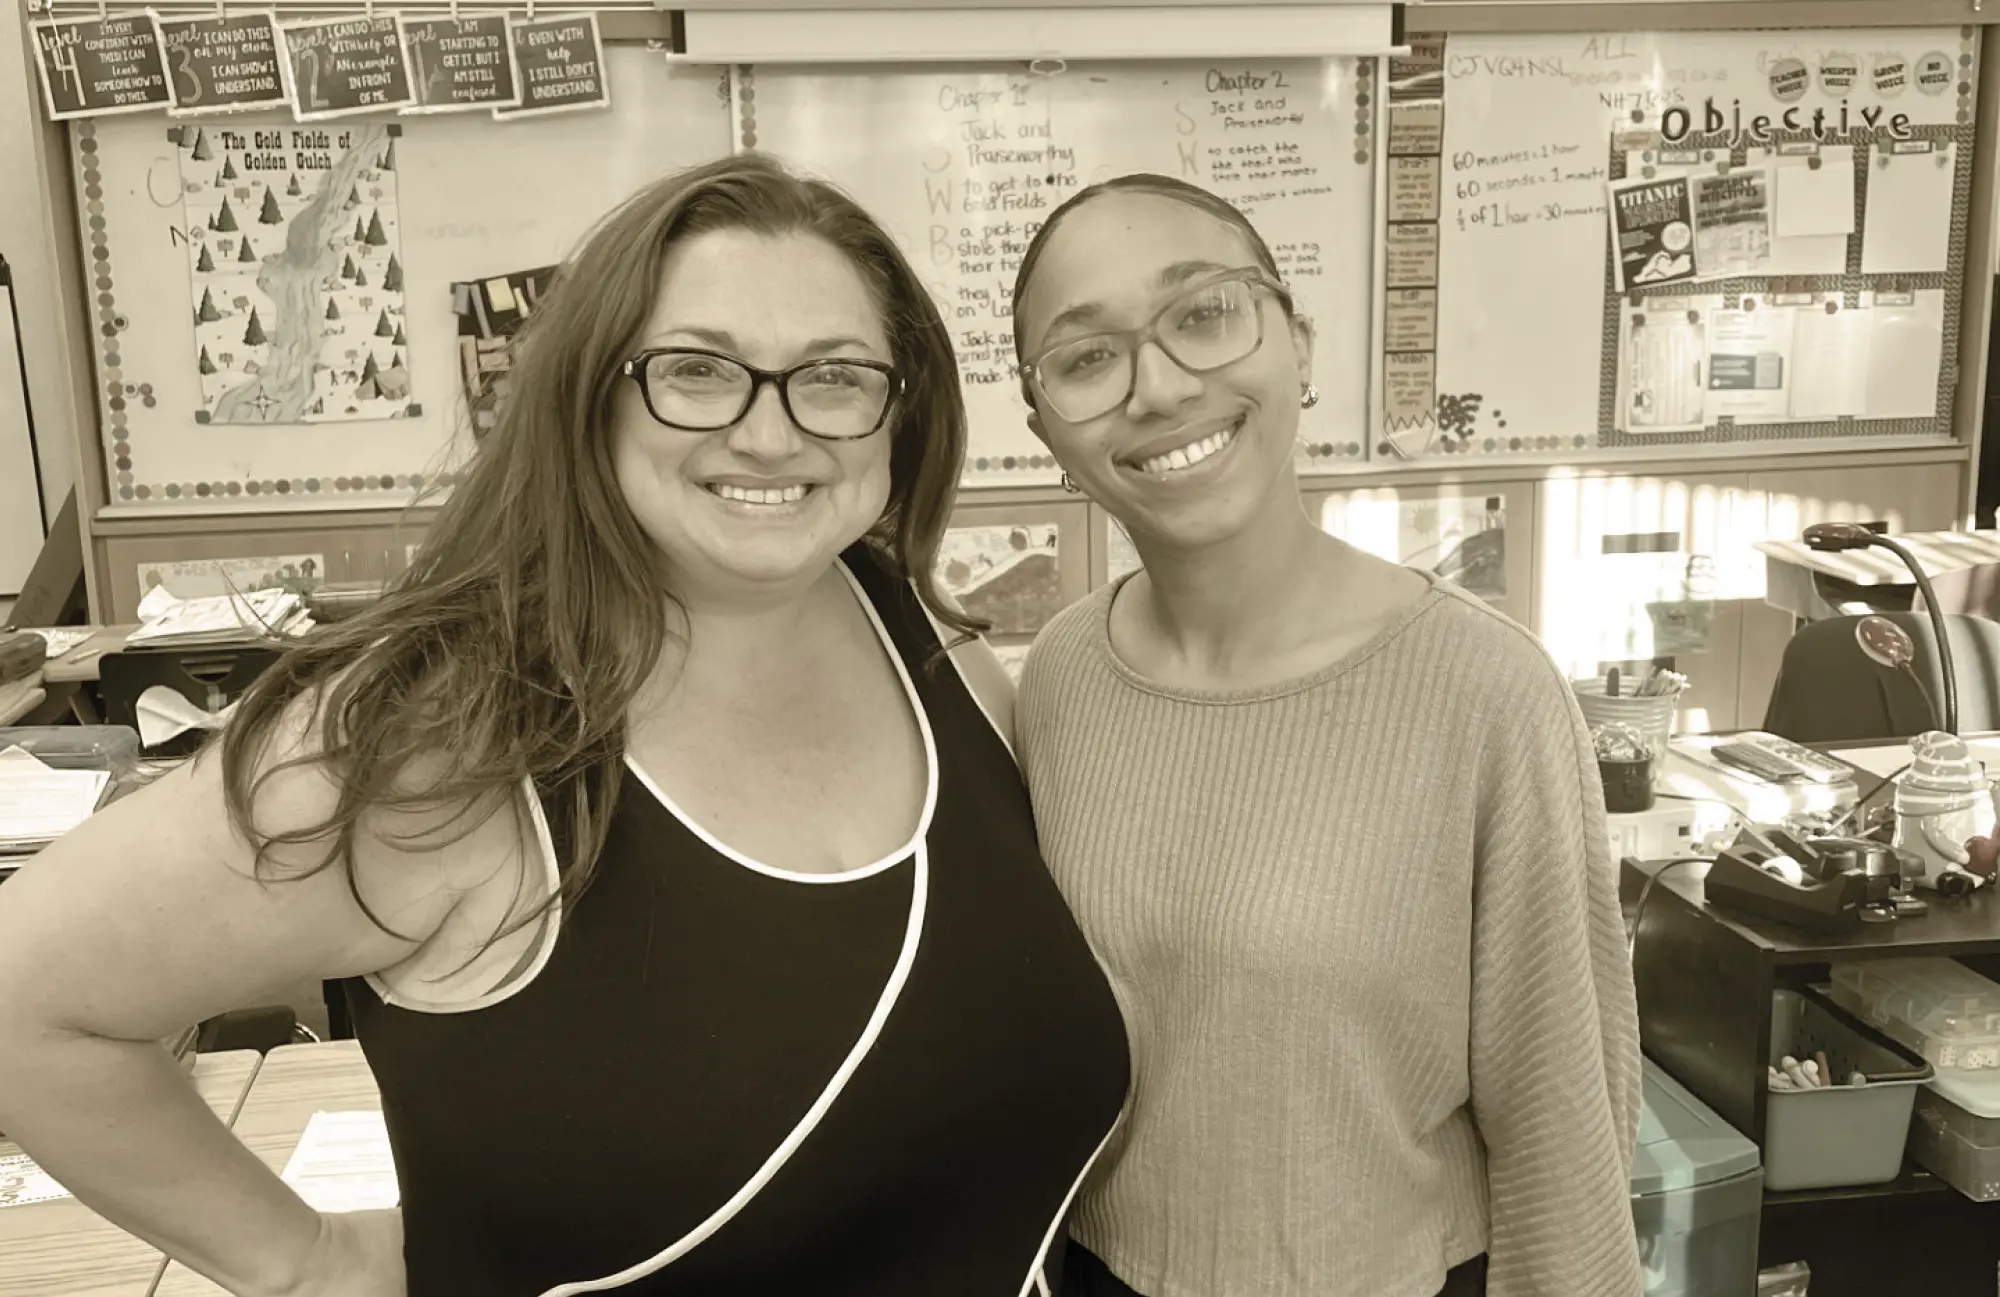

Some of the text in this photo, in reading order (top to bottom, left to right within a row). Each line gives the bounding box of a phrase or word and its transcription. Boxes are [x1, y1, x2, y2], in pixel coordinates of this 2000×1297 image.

[211, 30, 232, 44] CAN
[233, 28, 246, 42] DO
[246, 26, 271, 41] THIS
[333, 23, 355, 37] CAN
[355, 21, 368, 35] DO
[369, 18, 393, 33] THIS
[404, 24, 437, 45] evel
[464, 20, 478, 33] AM
[85, 34, 154, 51] CONFIDENT WITH
[329, 39, 356, 54] WITH
[383, 34, 397, 47] OR
[439, 36, 486, 51] STARTING
[487, 35, 499, 47] TO
[528, 31, 554, 46] EVEN
[555, 27, 584, 42] WITH
[128, 48, 146, 61] CAN
[1582, 36, 1637, 60] ALL
[336, 59, 350, 72] AN
[443, 53, 459, 68] GET
[476, 52, 492, 65] BUT
[171, 44, 202, 104] 3
[218, 64, 239, 78] CAN
[240, 61, 268, 76] SHOW
[301, 48, 329, 108] 2
[454, 68, 495, 83] AM STILL
[536, 65, 565, 81] STILL
[566, 61, 595, 78] DON'T
[1820, 67, 1857, 76] WHISPER
[94, 74, 162, 93] SOMEONE HOW TO
[215, 76, 278, 96] UNDERSTAND.
[348, 72, 392, 90] IN FRONT
[1206, 68, 1290, 96] Chapter 2
[1824, 77, 1850, 87] VOICE
[1875, 75, 1905, 90] VOICE
[1919, 73, 1948, 85] VOICE
[114, 92, 126, 104] DO
[360, 90, 371, 104] OF
[532, 80, 599, 99] UNDERSTAND.
[1255, 97, 1286, 111] and
[959, 118, 1052, 142] Jack and
[1661, 97, 1910, 147] Objective
[221, 130, 350, 150] The Gold Fields of
[1229, 144, 1267, 155] catch
[1275, 141, 1299, 153] the
[245, 152, 332, 170] Golden Gulch
[1452, 150, 1475, 171] 60
[1476, 150, 1531, 168] minutes
[1541, 145, 1549, 158] 1
[1552, 143, 1580, 155] hour
[963, 178, 982, 195] to
[989, 176, 1019, 199] get
[1025, 174, 1042, 189] to
[1456, 180, 1480, 200] 60
[1486, 173, 1536, 192] seconds
[1551, 167, 1563, 183] 1
[1002, 192, 1048, 211] Fields
[1618, 183, 1685, 207] TITANIC
[1471, 204, 1487, 224] of
[1491, 203, 1504, 228] 1
[1506, 203, 1530, 223] hour
[1544, 203, 1562, 221] 30
[960, 227, 974, 238] a
[958, 287, 990, 308] they
[956, 304, 976, 319] on
[960, 330, 996, 347] Jack
[966, 368, 1003, 384] made
